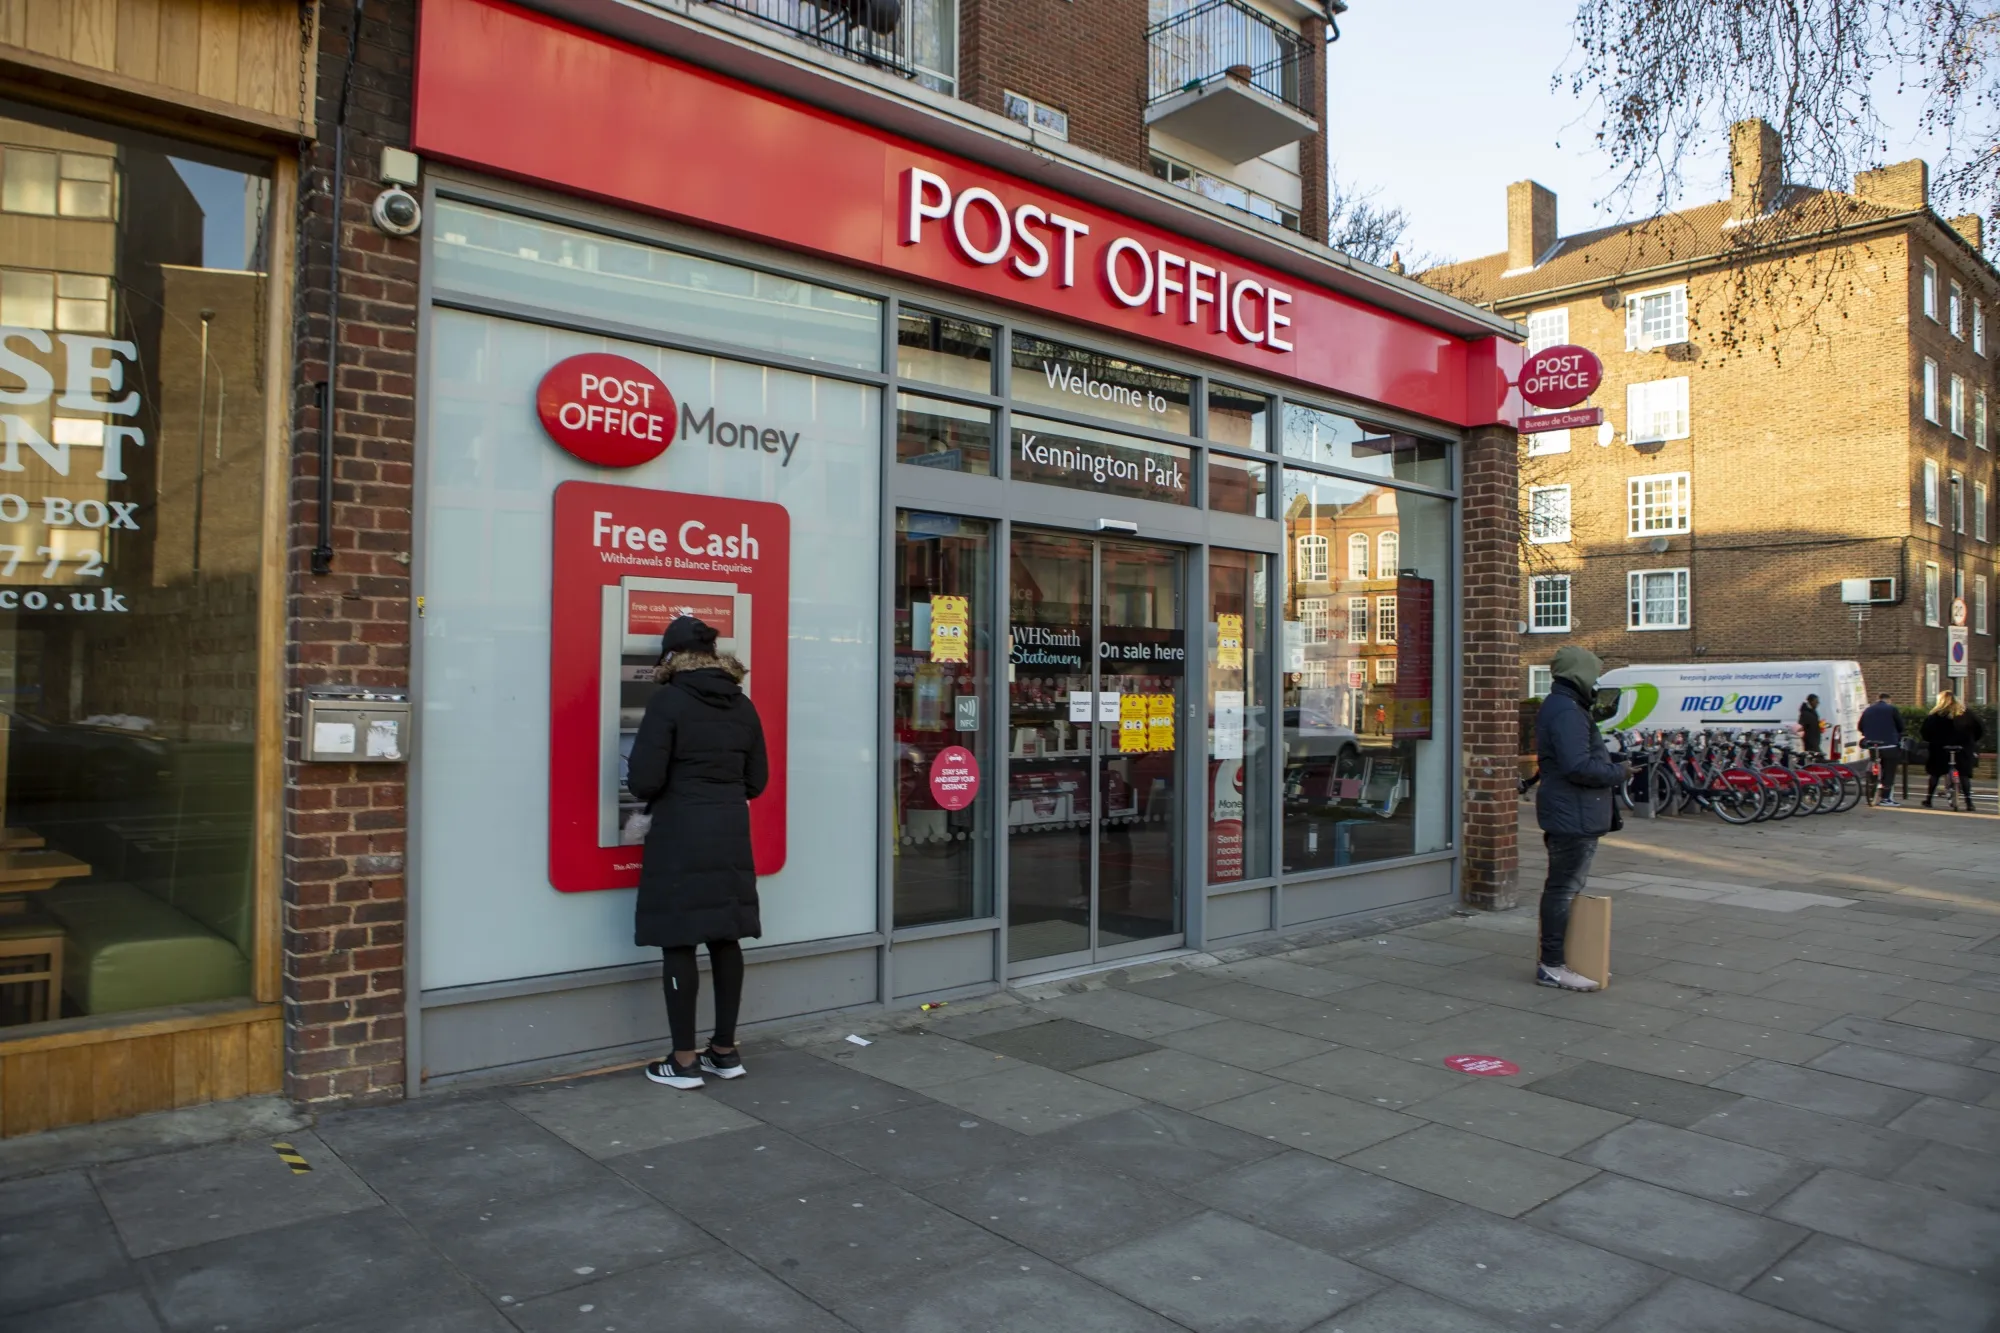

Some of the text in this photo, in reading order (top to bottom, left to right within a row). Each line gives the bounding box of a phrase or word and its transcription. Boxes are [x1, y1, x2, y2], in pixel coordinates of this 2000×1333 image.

[904, 166, 1294, 352] POST OFFICE
[1536, 355, 1583, 375] POST
[580, 373, 655, 409] POST
[1043, 360, 1167, 414] Welcome to
[1525, 373, 1588, 394] OFFICE
[559, 402, 664, 443] OFFICE
[1525, 419, 1550, 428] Bureau
[1562, 414, 1591, 424] Change
[681, 402, 800, 467] Money
[1021, 433, 1184, 489] Kennington Park
[42, 496, 141, 530] BOX
[593, 511, 760, 560] Free Cash
[600, 552, 753, 574] Withdrawals & Balance Enquiries
[631, 602, 648, 612] free
[649, 603, 667, 612] cash
[714, 607, 731, 616] here
[1012, 626, 1081, 647] WHSmith
[1010, 645, 1081, 669] Stationery
[1100, 641, 1184, 660] On sale here
[1680, 671, 1821, 682] keeping people independent for longer
[959, 719, 974, 728] NFC
[942, 783, 968, 791] DISTANCE
[960, 775, 975, 783] YOUR
[1217, 834, 1239, 844] Send
